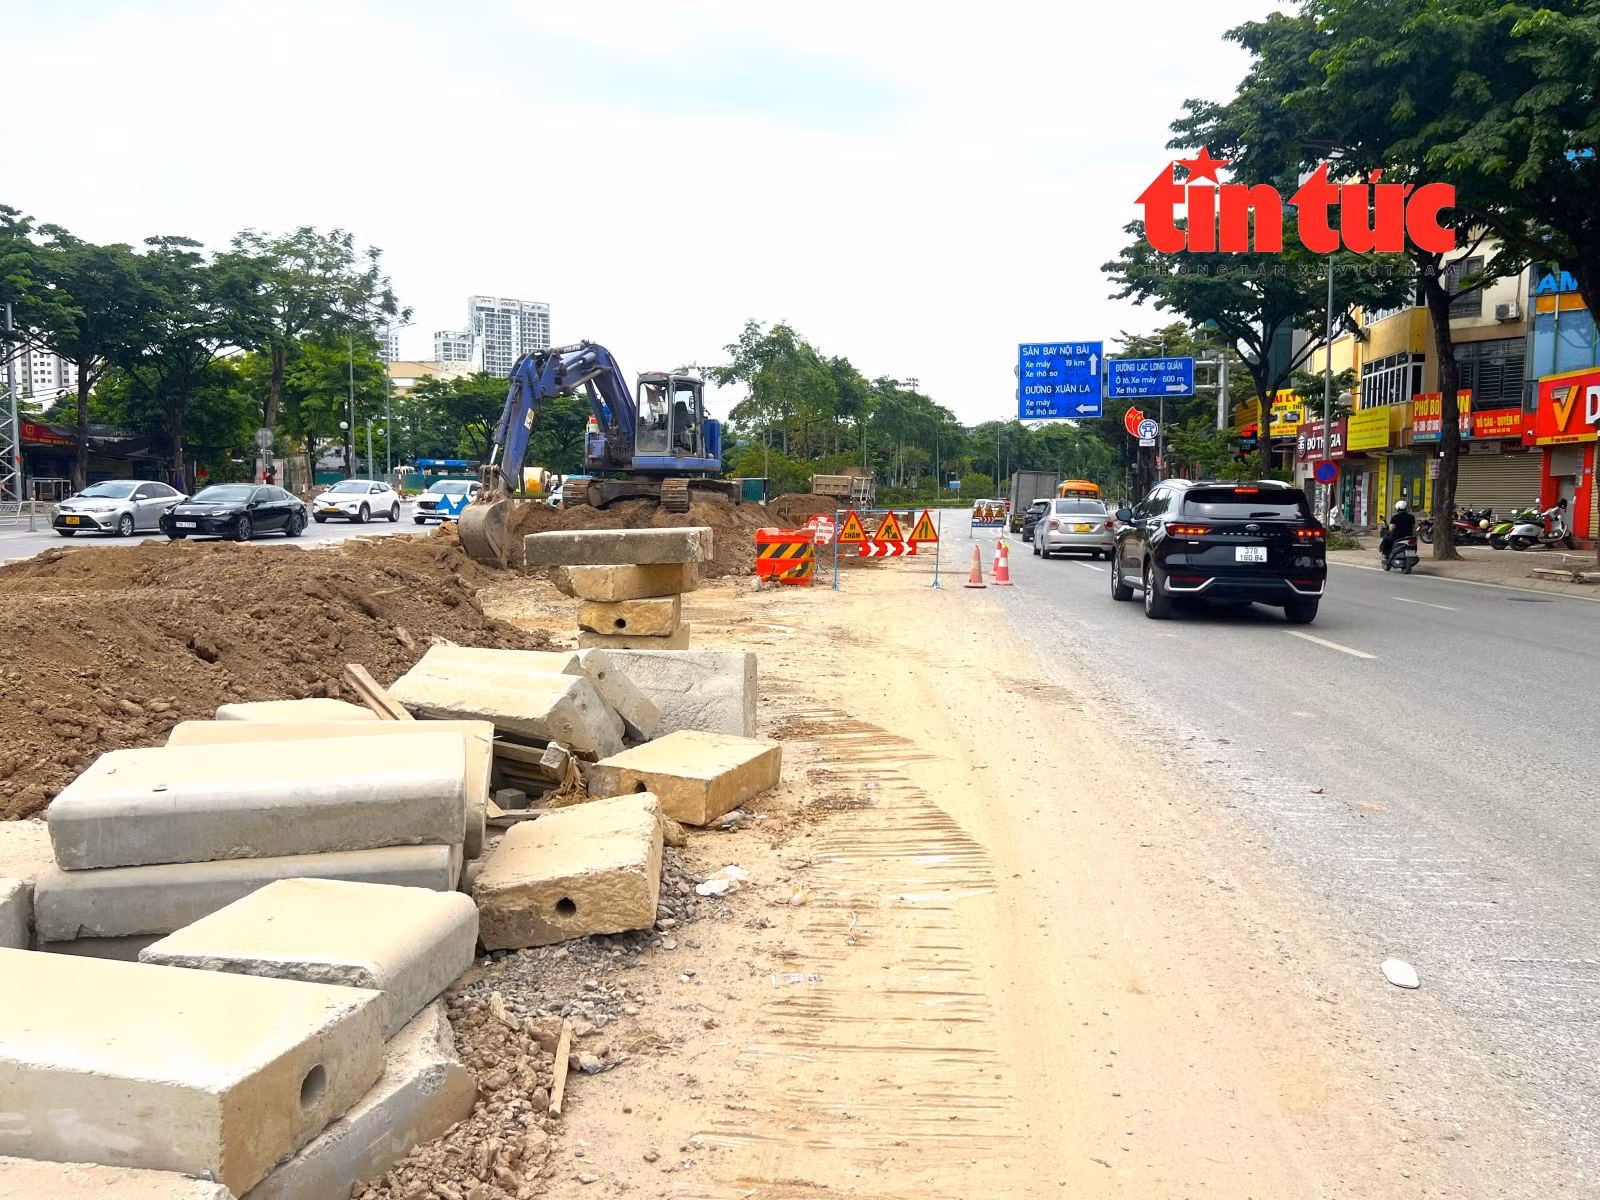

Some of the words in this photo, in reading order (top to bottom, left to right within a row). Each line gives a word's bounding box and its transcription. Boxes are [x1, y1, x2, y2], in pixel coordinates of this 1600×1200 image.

[1022, 346, 1040, 356] SÂN
[1043, 346, 1057, 355] BAY
[1059, 345, 1073, 356] NỘI
[1076, 344, 1090, 354] BÀI
[1036, 361, 1051, 369] máy
[1115, 361, 1135, 372] ĐƯỜNG
[1137, 362, 1148, 373] LẠC
[1150, 362, 1165, 371] LONG
[1167, 360, 1183, 370] QUÂN
[1115, 376, 1121, 384] Ô
[1131, 376, 1140, 384] Xe
[1142, 376, 1157, 384] máy
[1025, 384, 1052, 394] ĐƯỜNG
[1055, 383, 1077, 394] XUÂN
[1079, 385, 1091, 393] LA
[1036, 399, 1051, 407] máy
